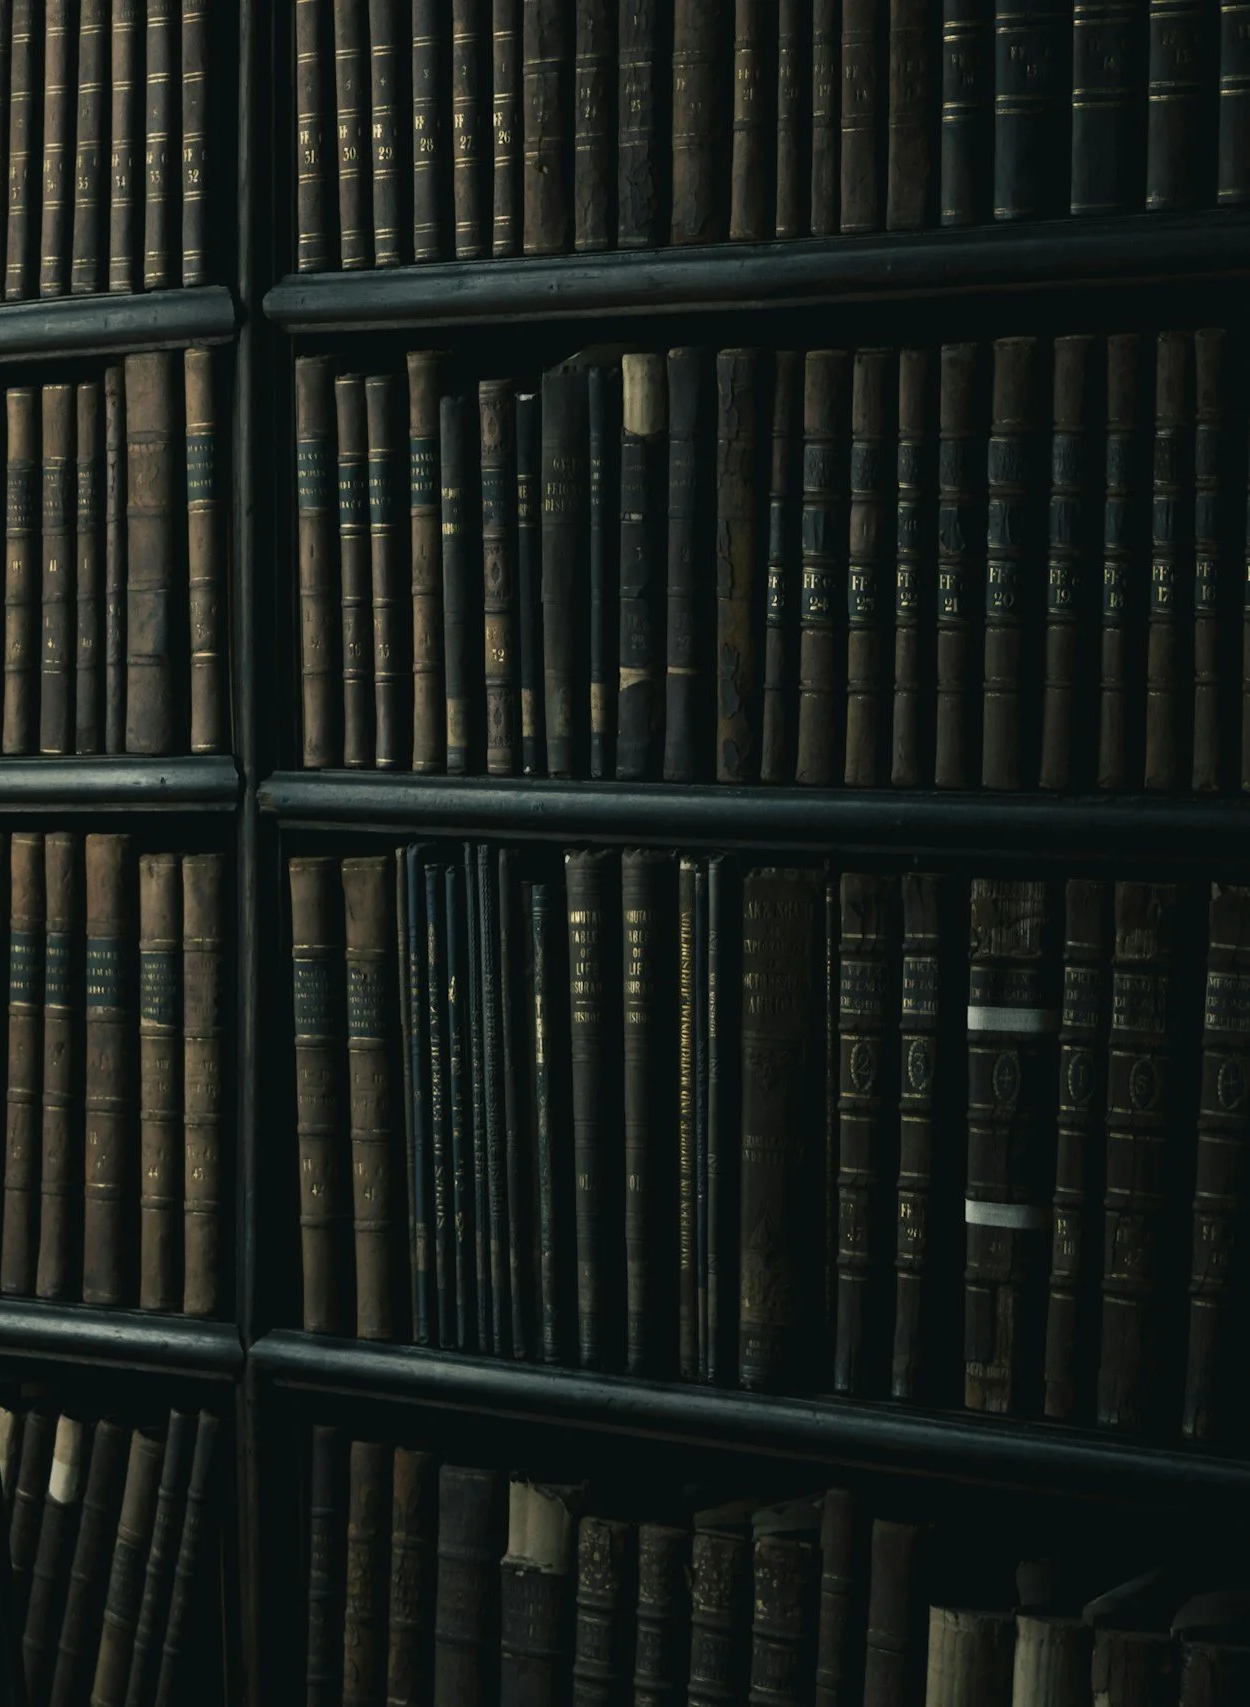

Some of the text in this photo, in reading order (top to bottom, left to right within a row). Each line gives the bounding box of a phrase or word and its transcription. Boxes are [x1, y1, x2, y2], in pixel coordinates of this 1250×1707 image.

[547, 482, 582, 495] FEIGN
[994, 592, 1014, 606] 20
[743, 900, 770, 919] AKE
[572, 930, 598, 943] TABLE
[576, 962, 599, 976] LIFE
[629, 962, 647, 976] LIF
[1070, 971, 1093, 984] PRI
[857, 1053, 870, 1075] 2
